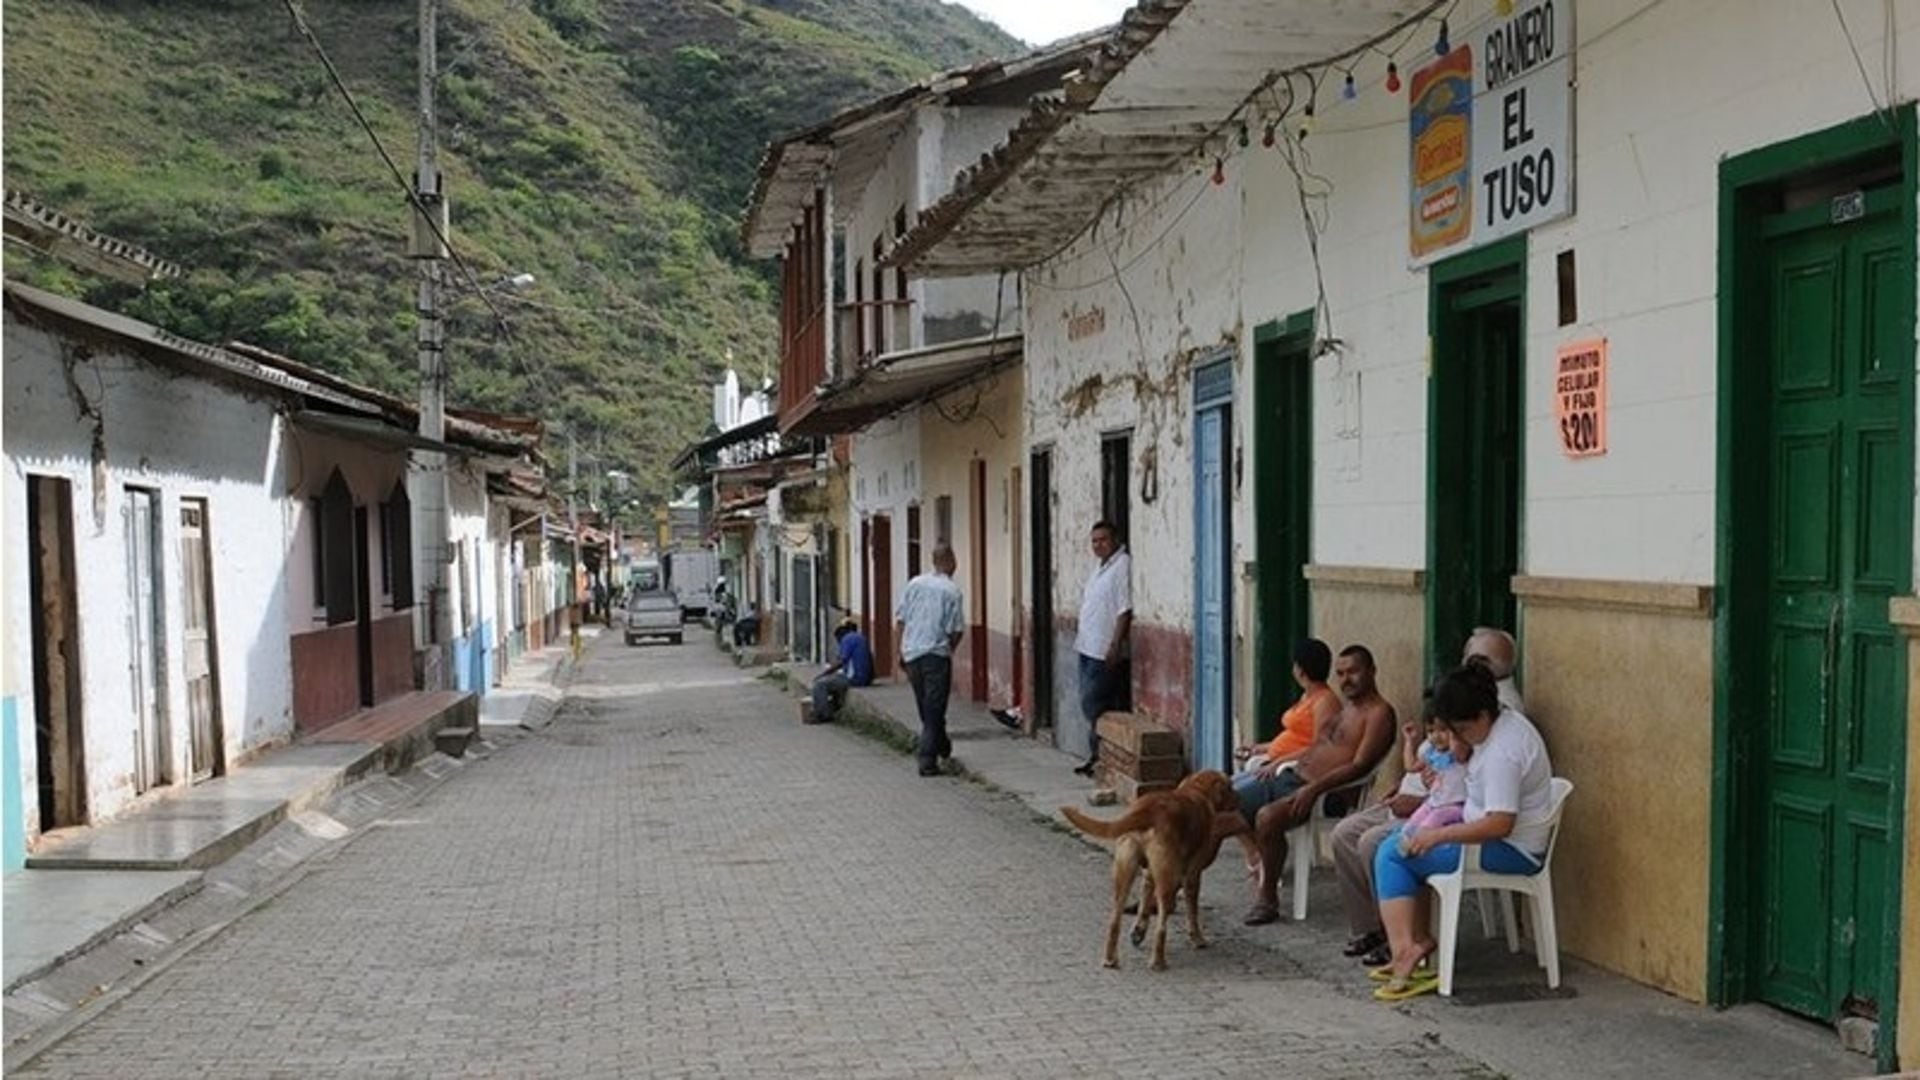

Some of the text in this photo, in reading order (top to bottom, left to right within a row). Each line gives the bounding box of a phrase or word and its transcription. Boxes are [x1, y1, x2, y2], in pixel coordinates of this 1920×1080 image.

[1485, 1, 1554, 90] GRANERO
[1503, 87, 1534, 151] EL
[1483, 148, 1554, 226] TUSO
[1557, 371, 1599, 393] CELULAR
[1572, 391, 1596, 410] FIJO
